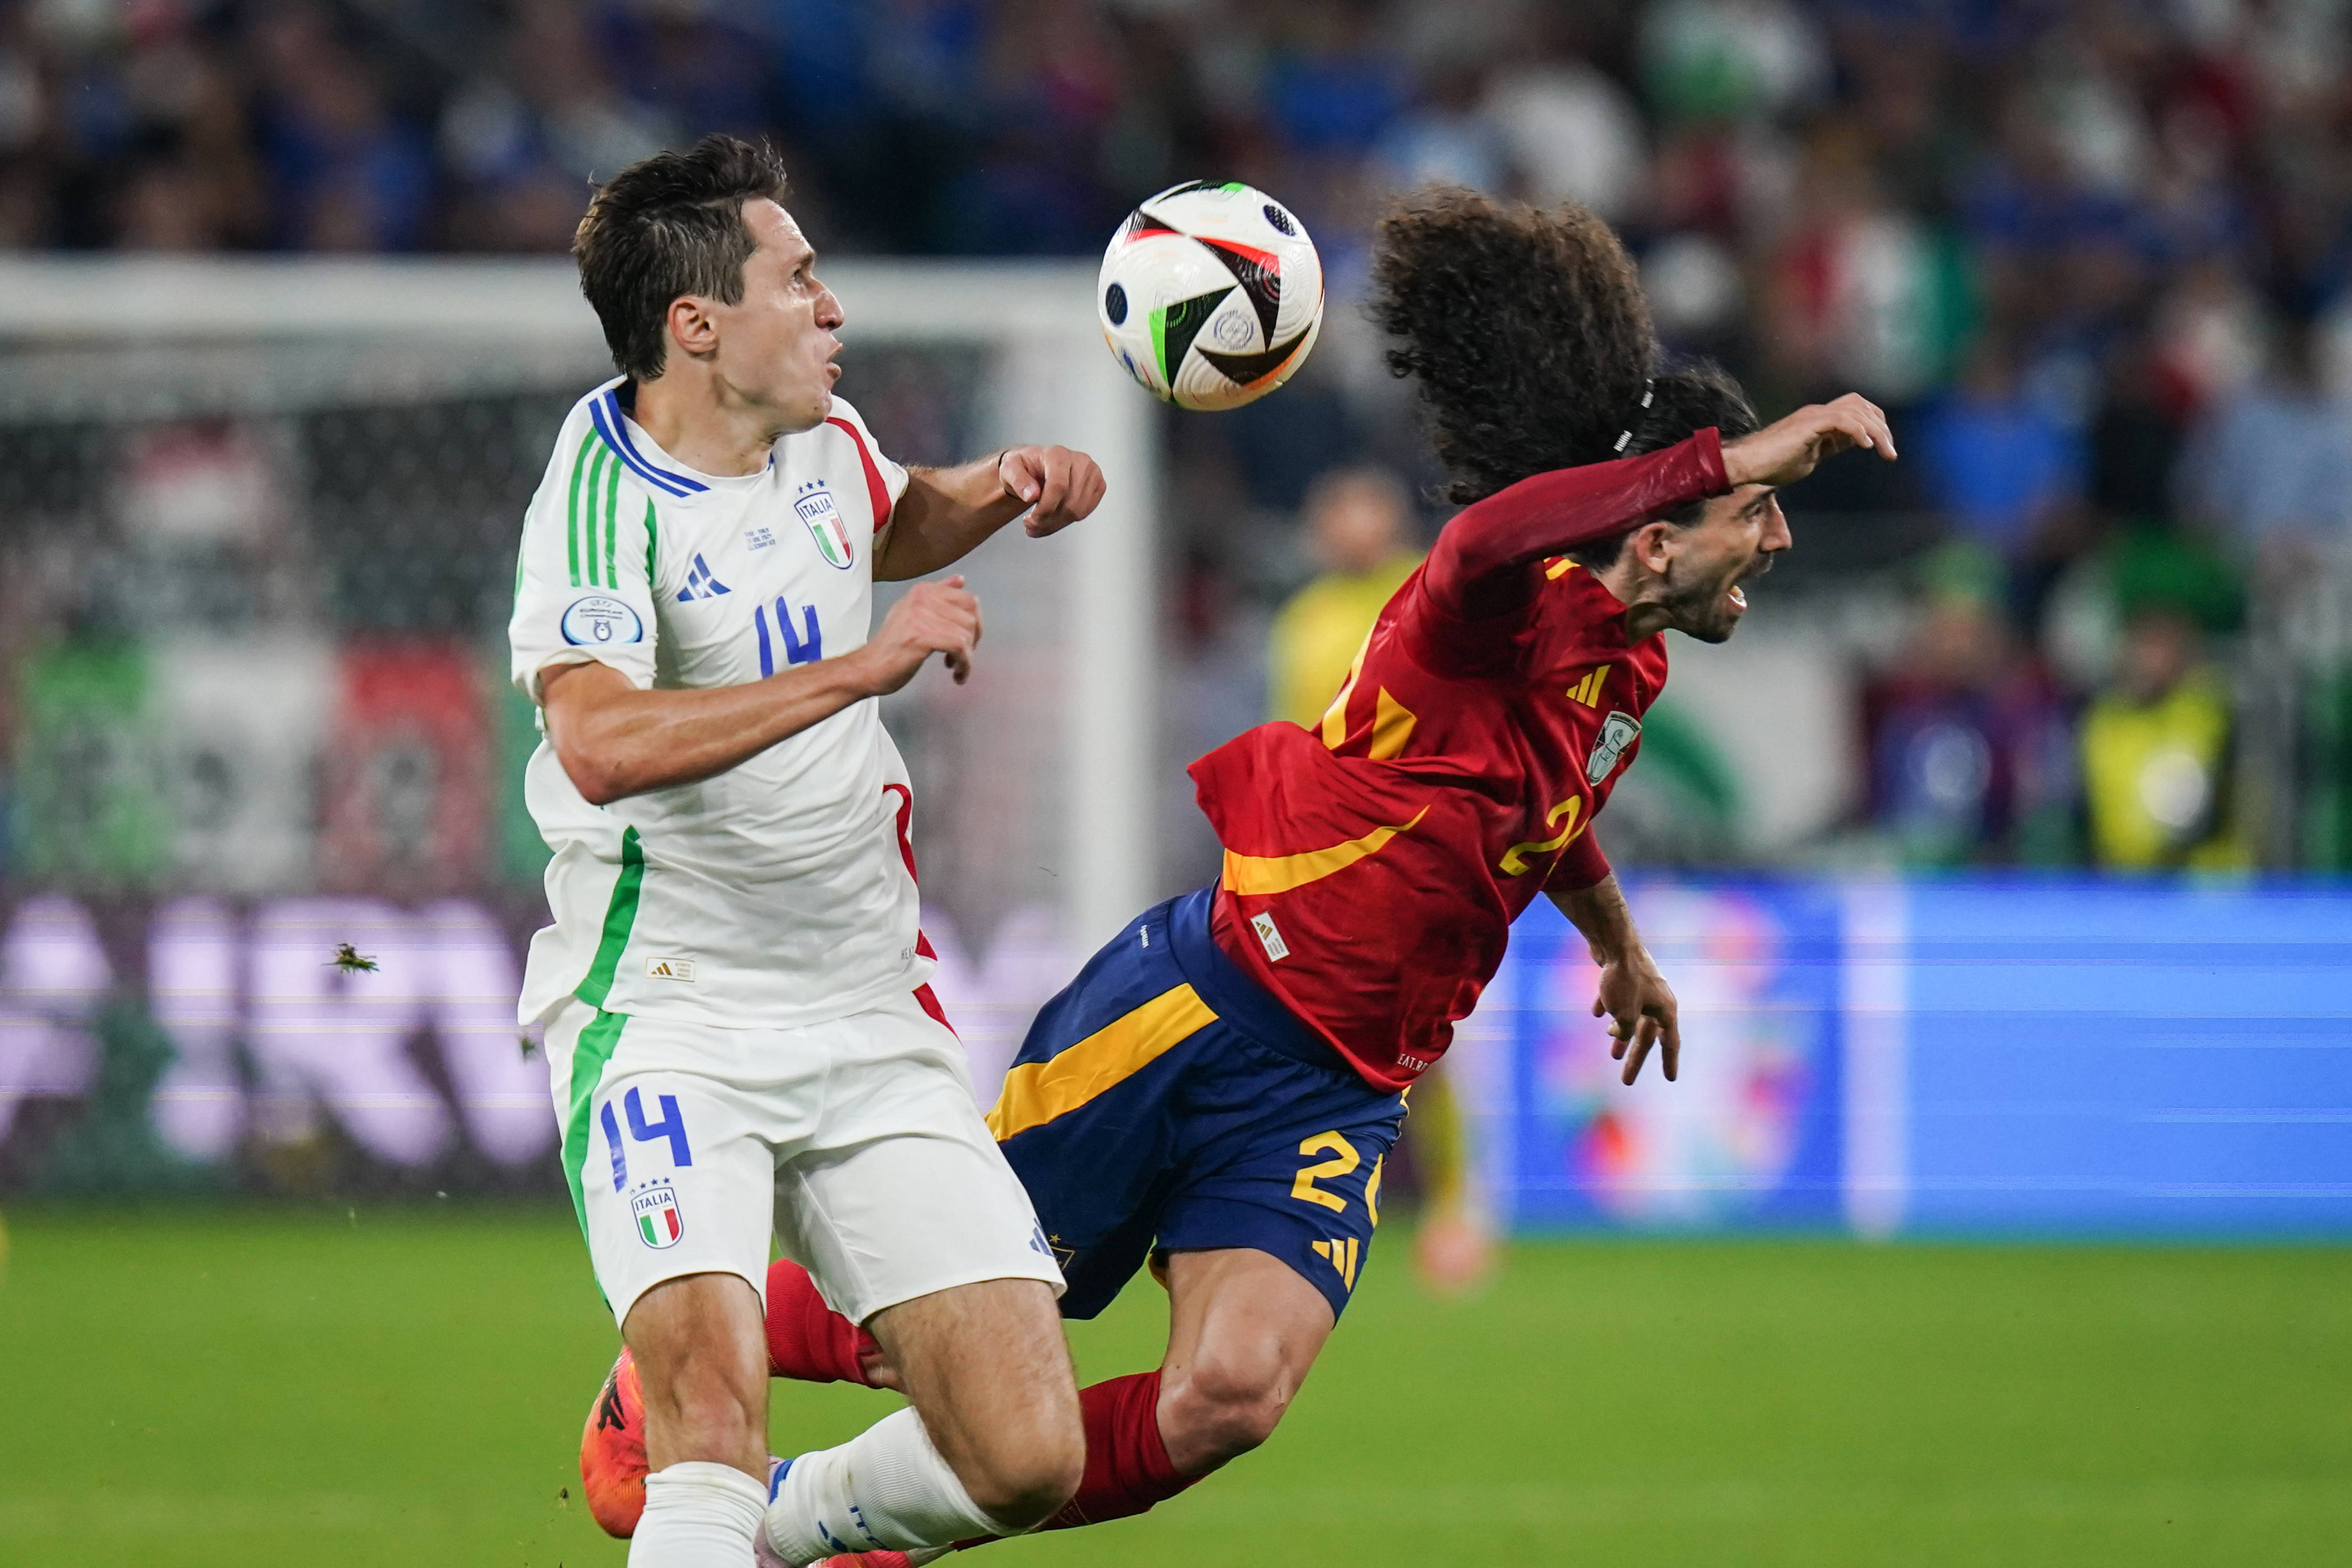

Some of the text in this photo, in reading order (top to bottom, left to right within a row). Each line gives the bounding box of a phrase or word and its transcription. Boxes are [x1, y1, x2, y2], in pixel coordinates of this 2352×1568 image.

[799, 498, 833, 519] ITALIA
[755, 595, 822, 679] 14
[1499, 795, 1589, 876] 2
[601, 1086, 693, 1193] 14
[635, 1192, 672, 1211] ITALIA
